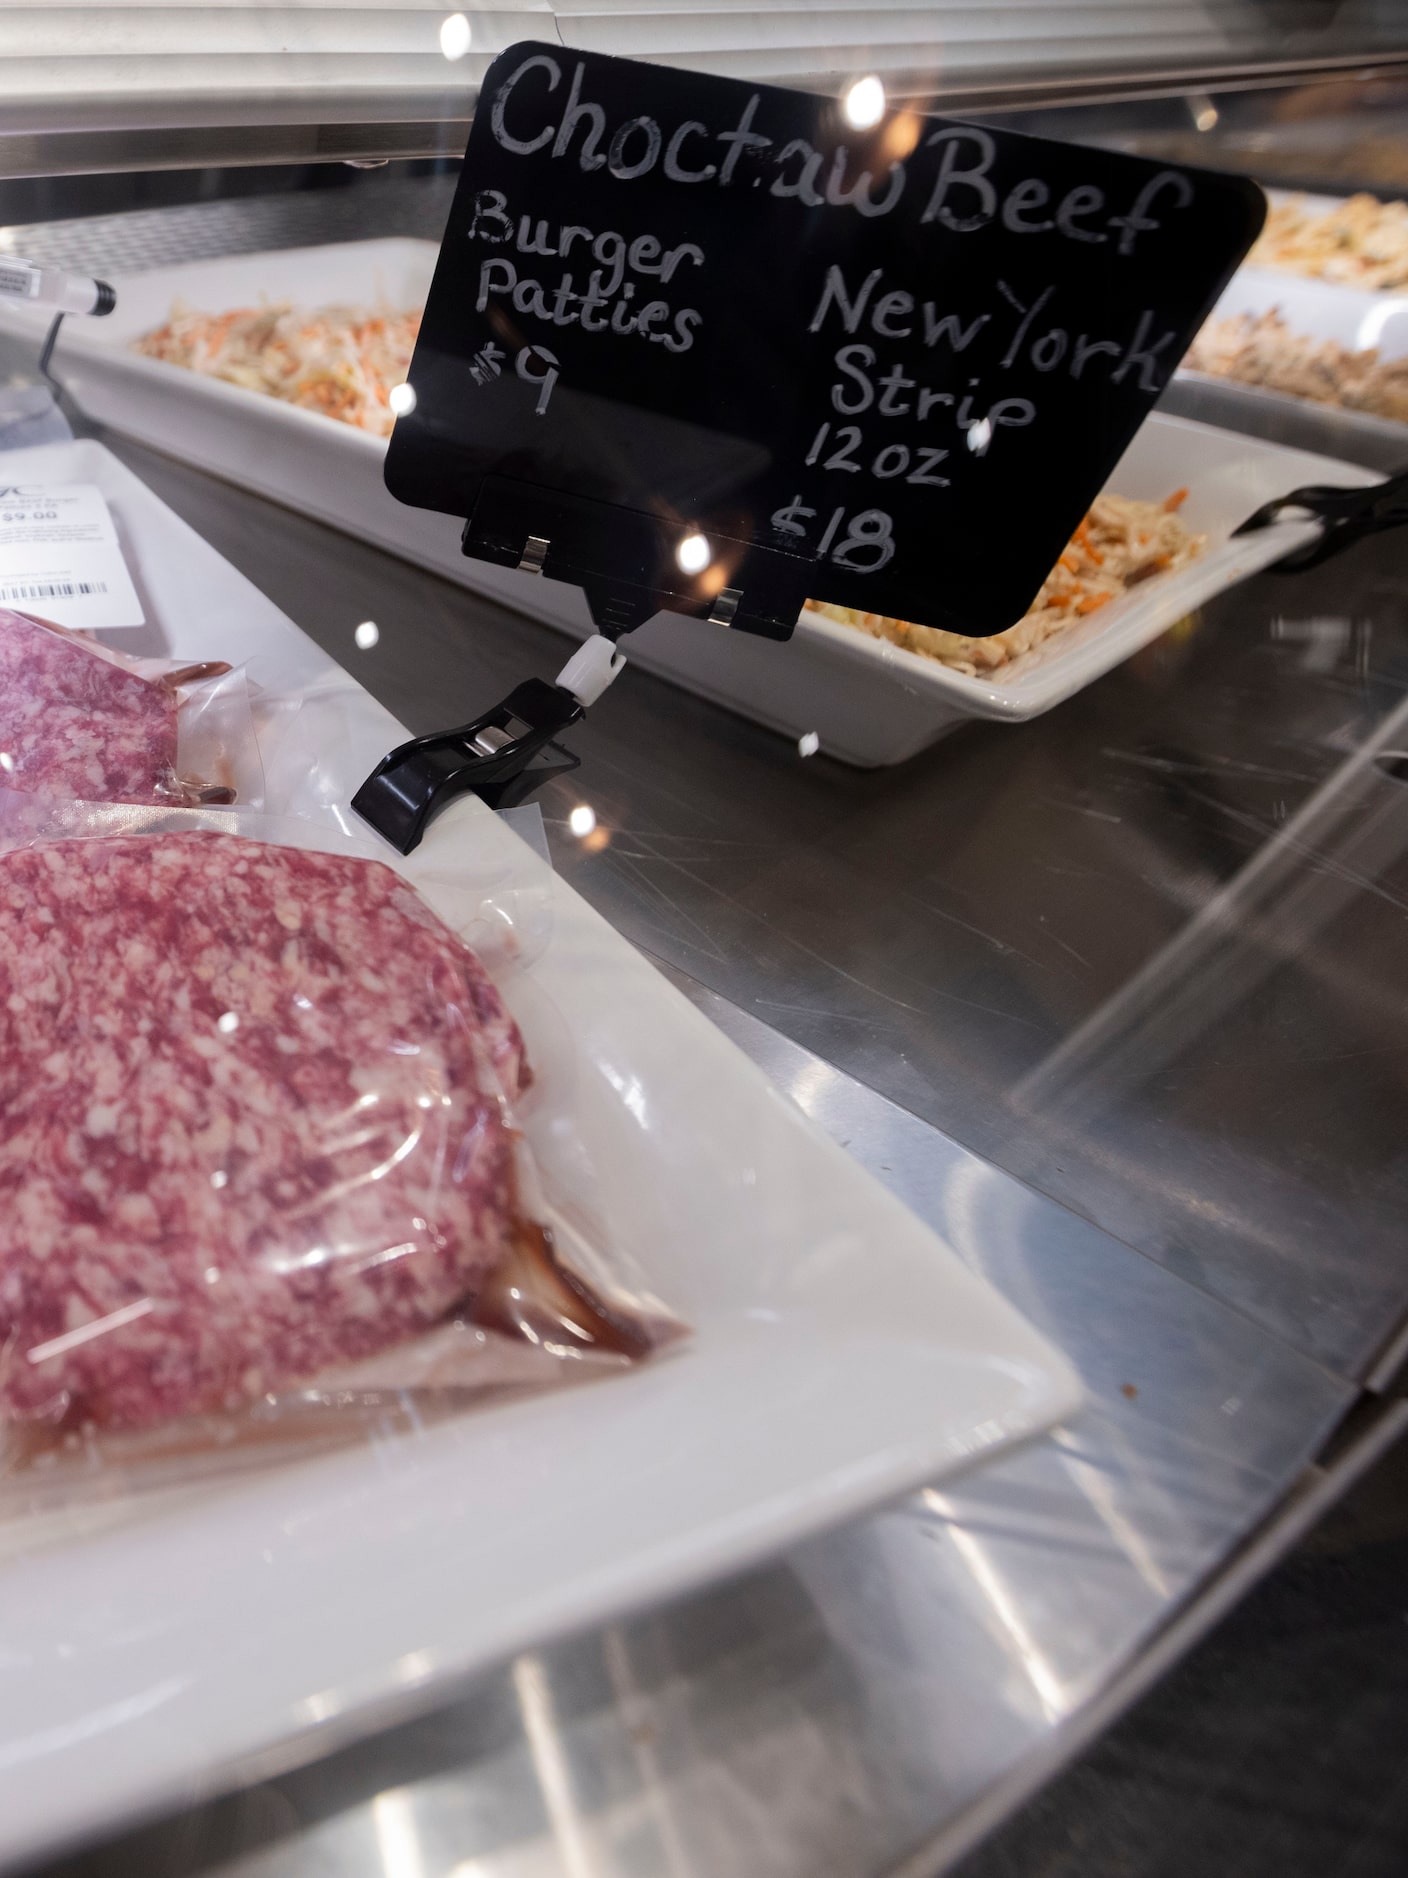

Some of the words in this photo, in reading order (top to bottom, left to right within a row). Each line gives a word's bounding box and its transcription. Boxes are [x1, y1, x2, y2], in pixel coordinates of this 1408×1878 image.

[491, 54, 906, 218] Choctaw
[922, 126, 1192, 254] Beef
[468, 190, 704, 295] Burger
[475, 258, 703, 353] Patties
[807, 264, 991, 351] New
[996, 279, 1176, 393] York
[831, 344, 1036, 457] Strip
[2, 510, 57, 522] $9.00
[770, 494, 896, 574] $18
